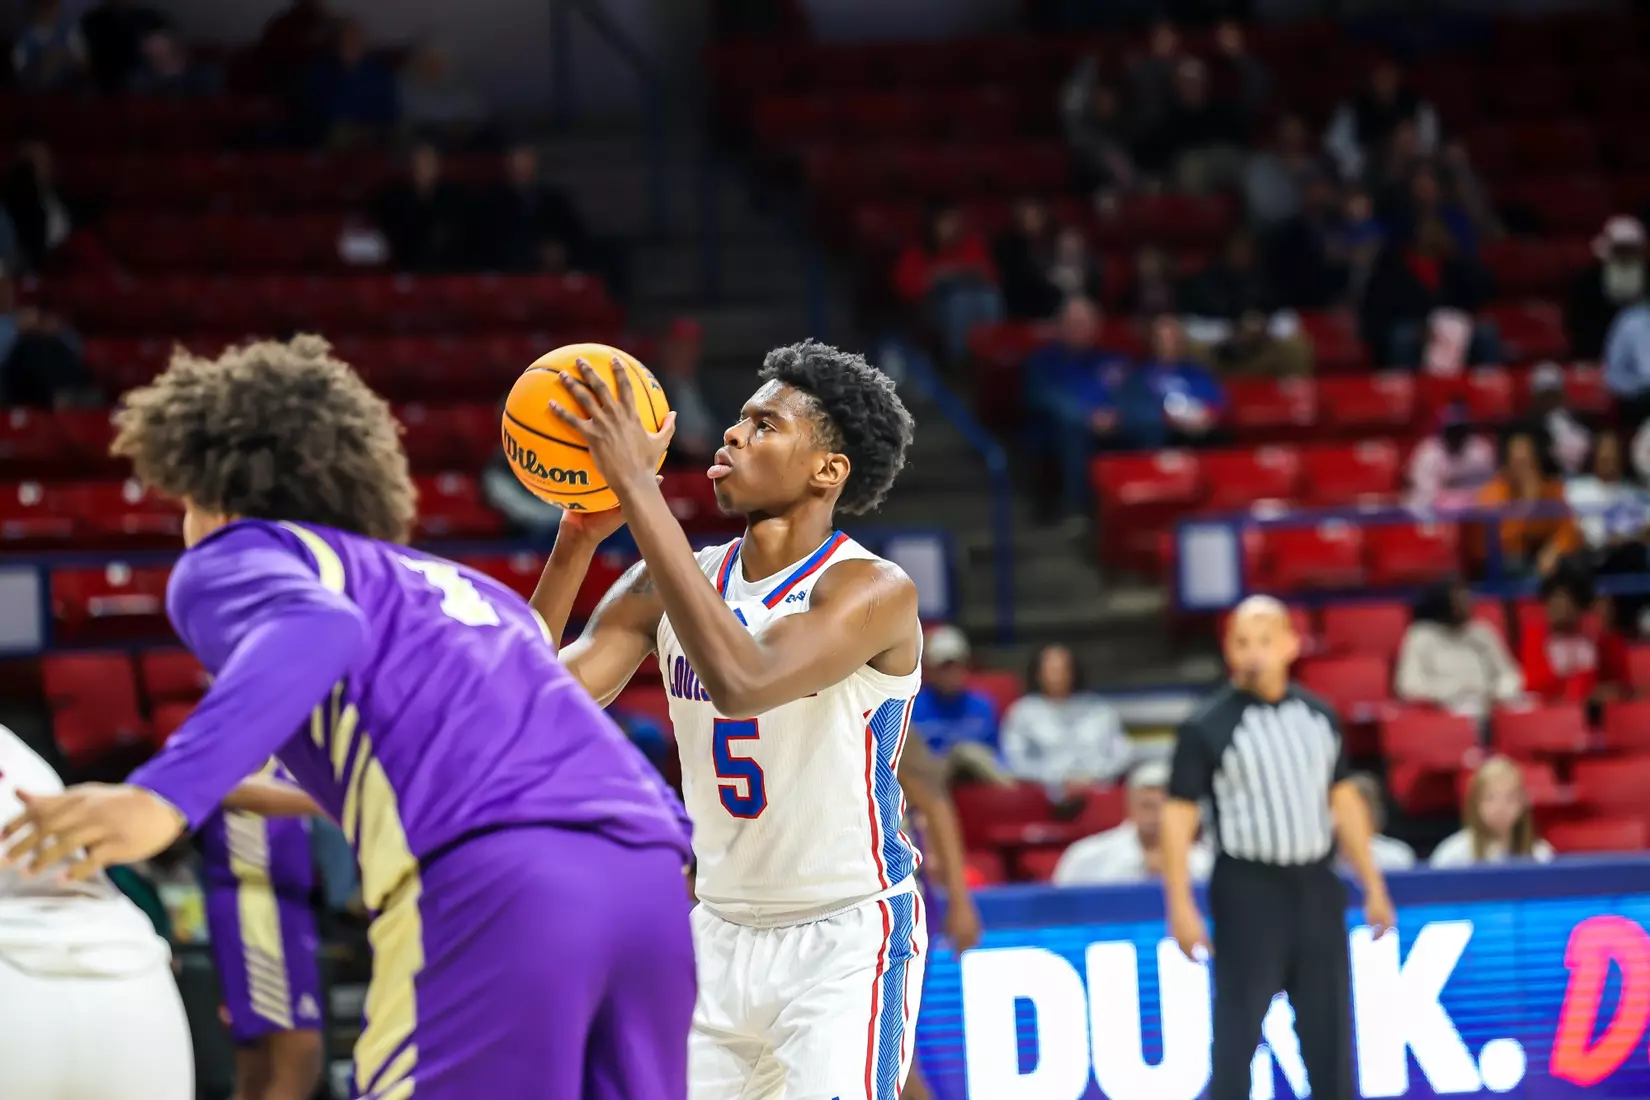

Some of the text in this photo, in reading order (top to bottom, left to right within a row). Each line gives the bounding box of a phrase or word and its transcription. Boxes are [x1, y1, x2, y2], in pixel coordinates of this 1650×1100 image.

[503, 427, 589, 486] Wilson
[712, 717, 768, 819] 5
[960, 919, 1527, 1100] DUK.
